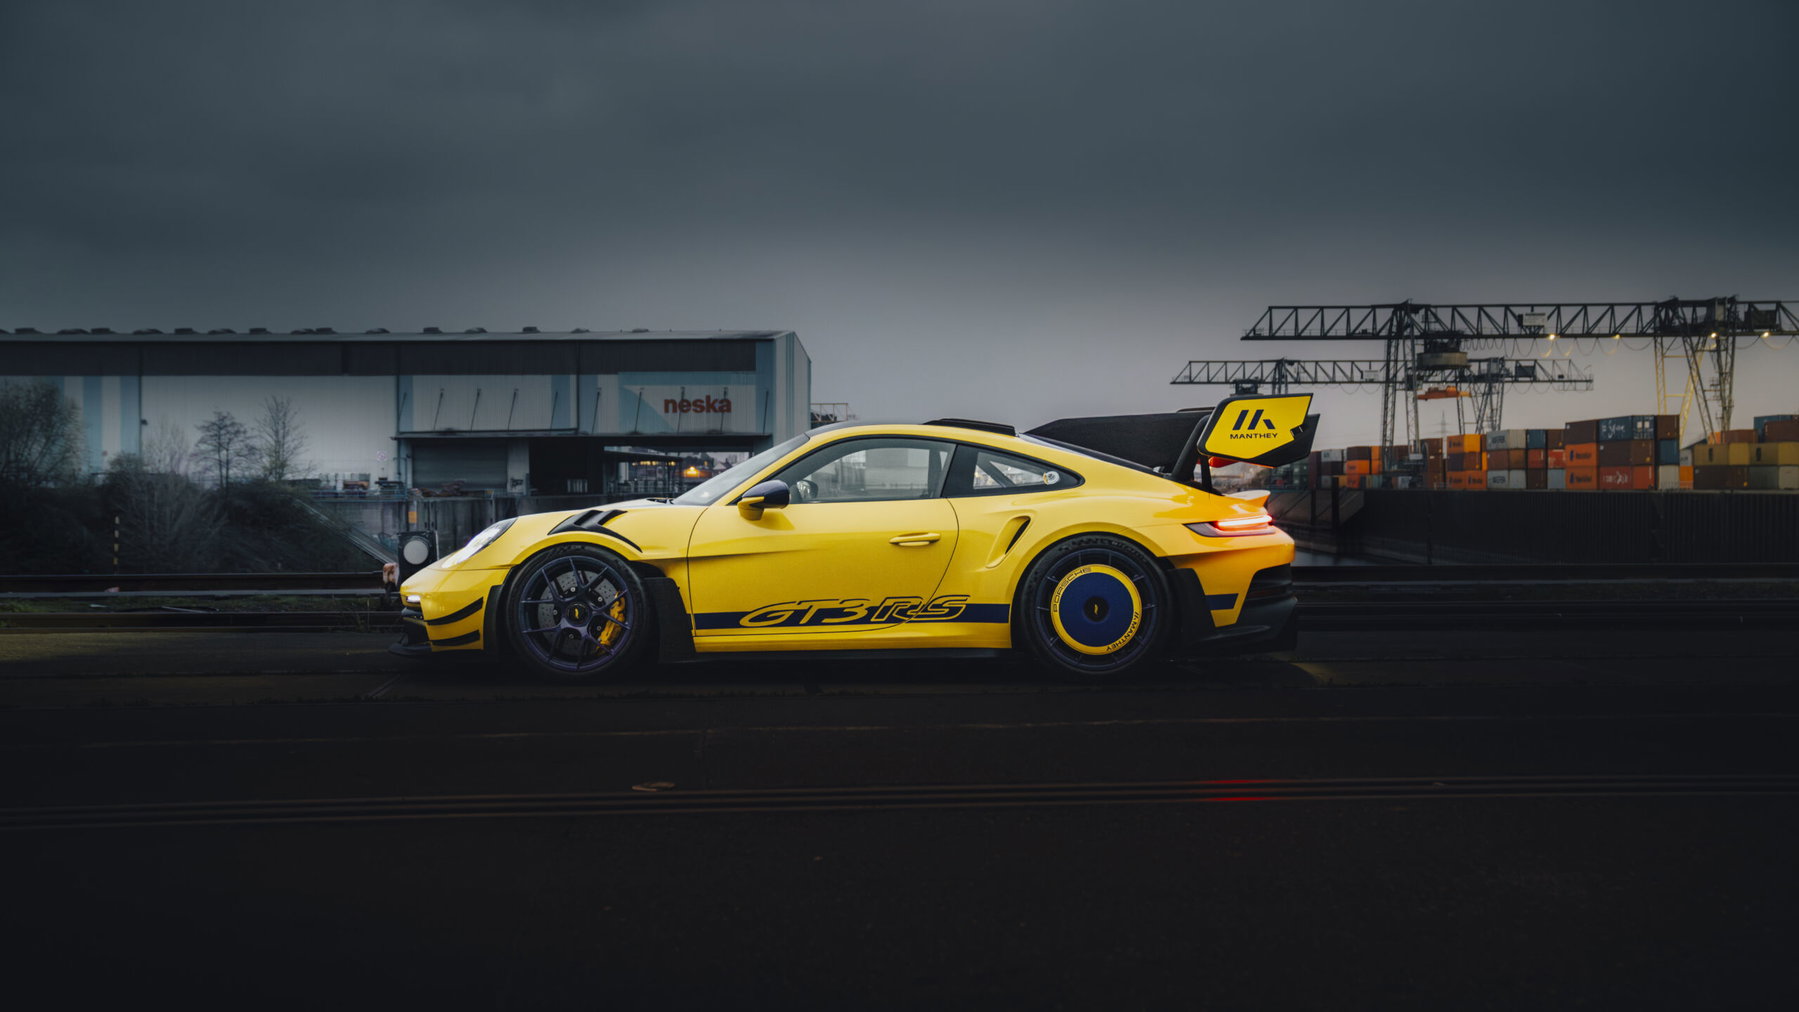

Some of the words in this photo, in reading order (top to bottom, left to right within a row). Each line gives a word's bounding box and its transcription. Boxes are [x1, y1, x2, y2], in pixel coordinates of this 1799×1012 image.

[663, 394, 732, 413] neska
[1053, 566, 1092, 613] PORSCHE
[1106, 621, 1138, 652] MANTHEY
